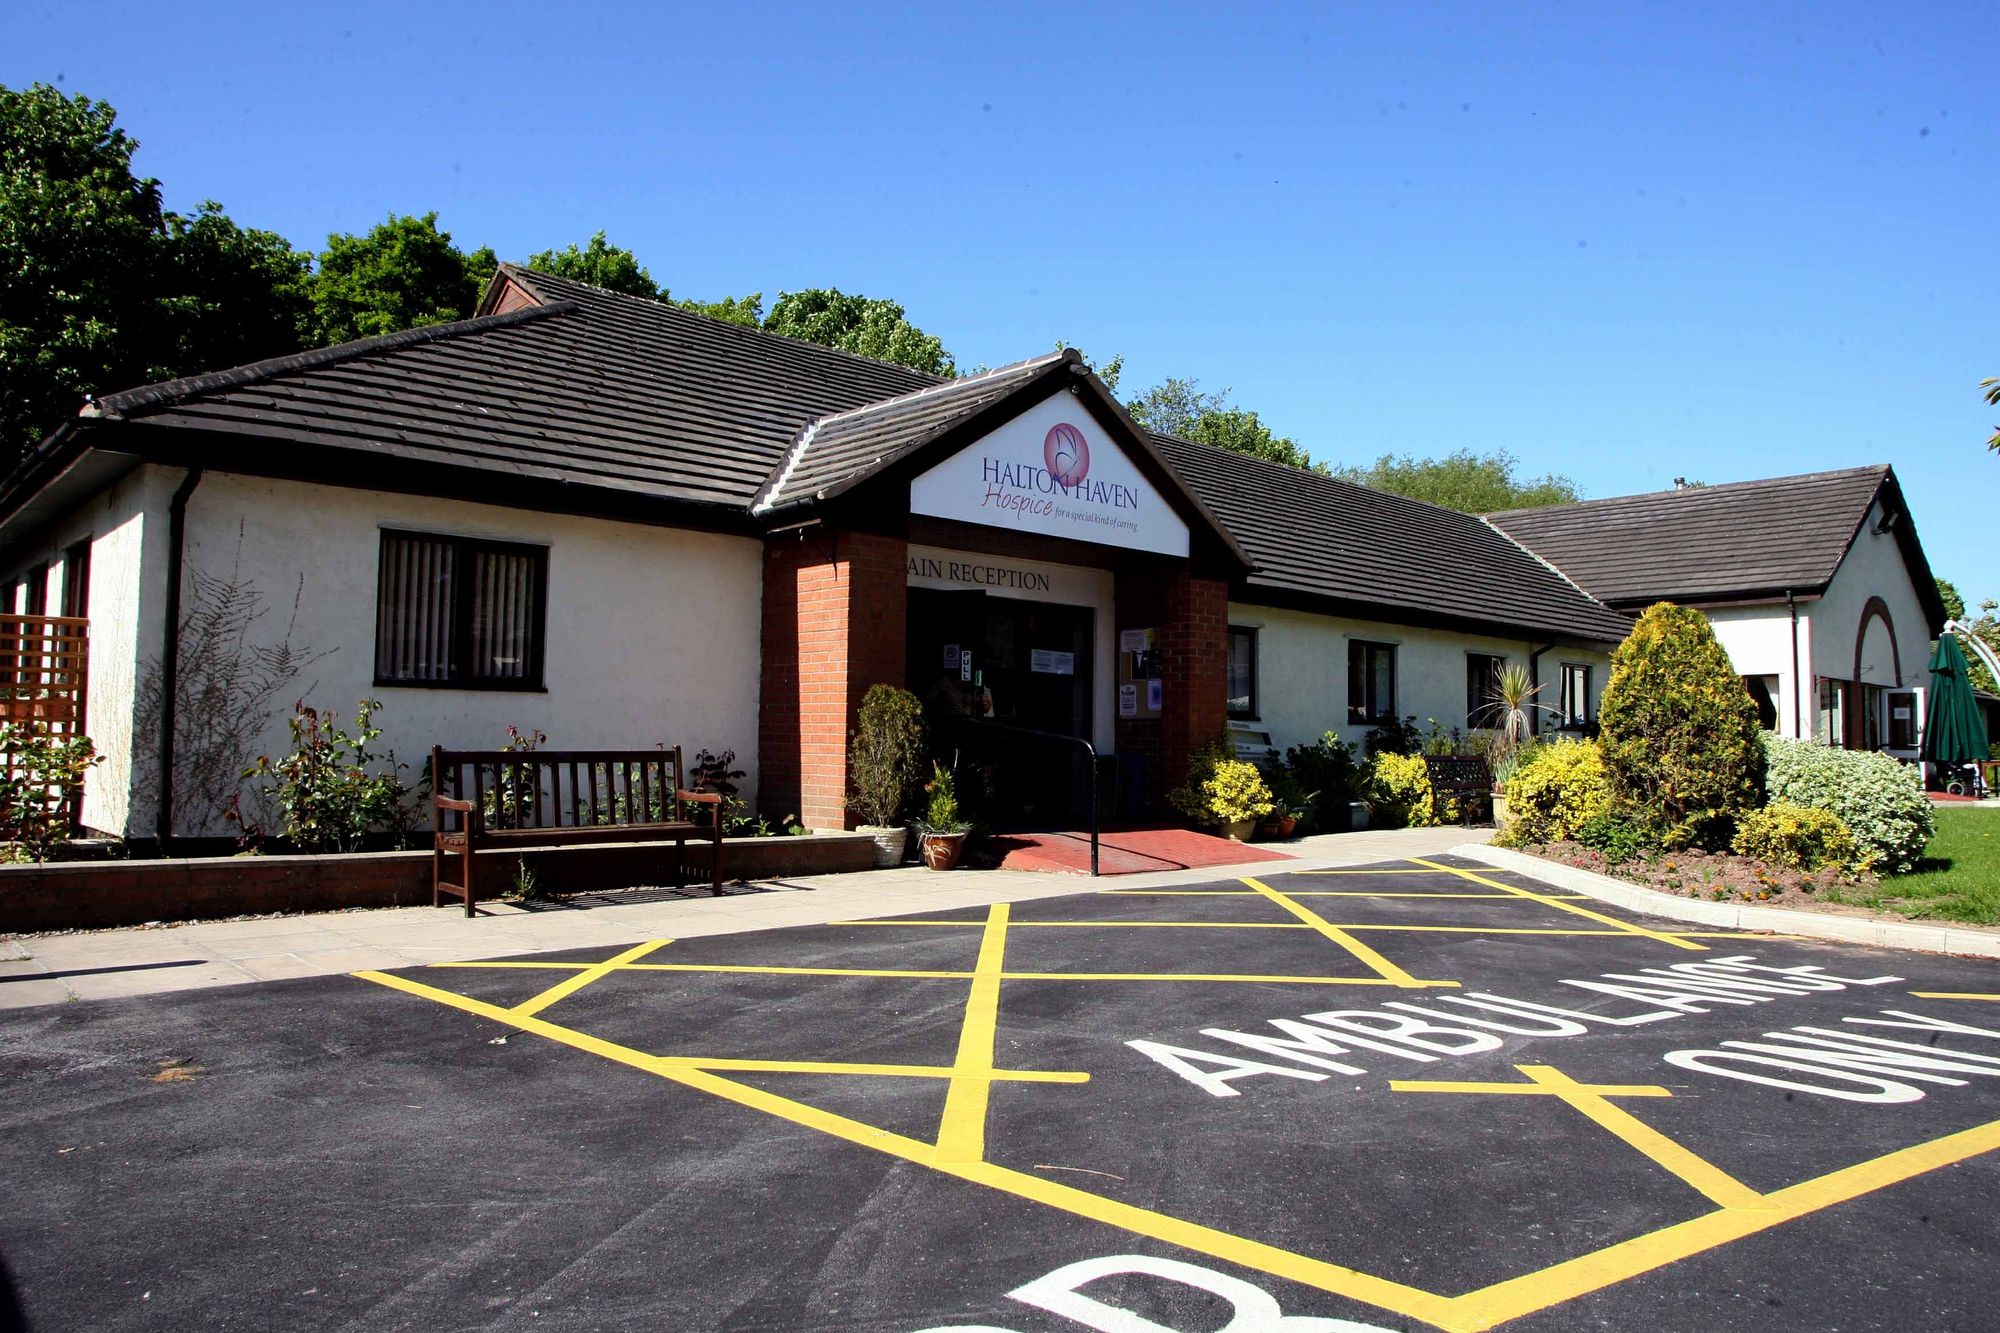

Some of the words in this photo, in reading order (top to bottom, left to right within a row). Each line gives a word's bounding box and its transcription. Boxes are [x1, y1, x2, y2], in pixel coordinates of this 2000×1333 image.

[981, 482, 1053, 521] Hospice
[982, 456, 1069, 497] HALTON
[1075, 476, 1138, 511] HAVEN
[1054, 506, 1066, 519] for
[1071, 511, 1094, 523] special
[1094, 513, 1110, 526] kind
[1109, 516, 1118, 529] of
[1116, 519, 1139, 533] caring
[907, 557, 942, 579] AIN
[948, 562, 1050, 592] RECEPTION
[1123, 955, 1906, 1097] AMBULANCE
